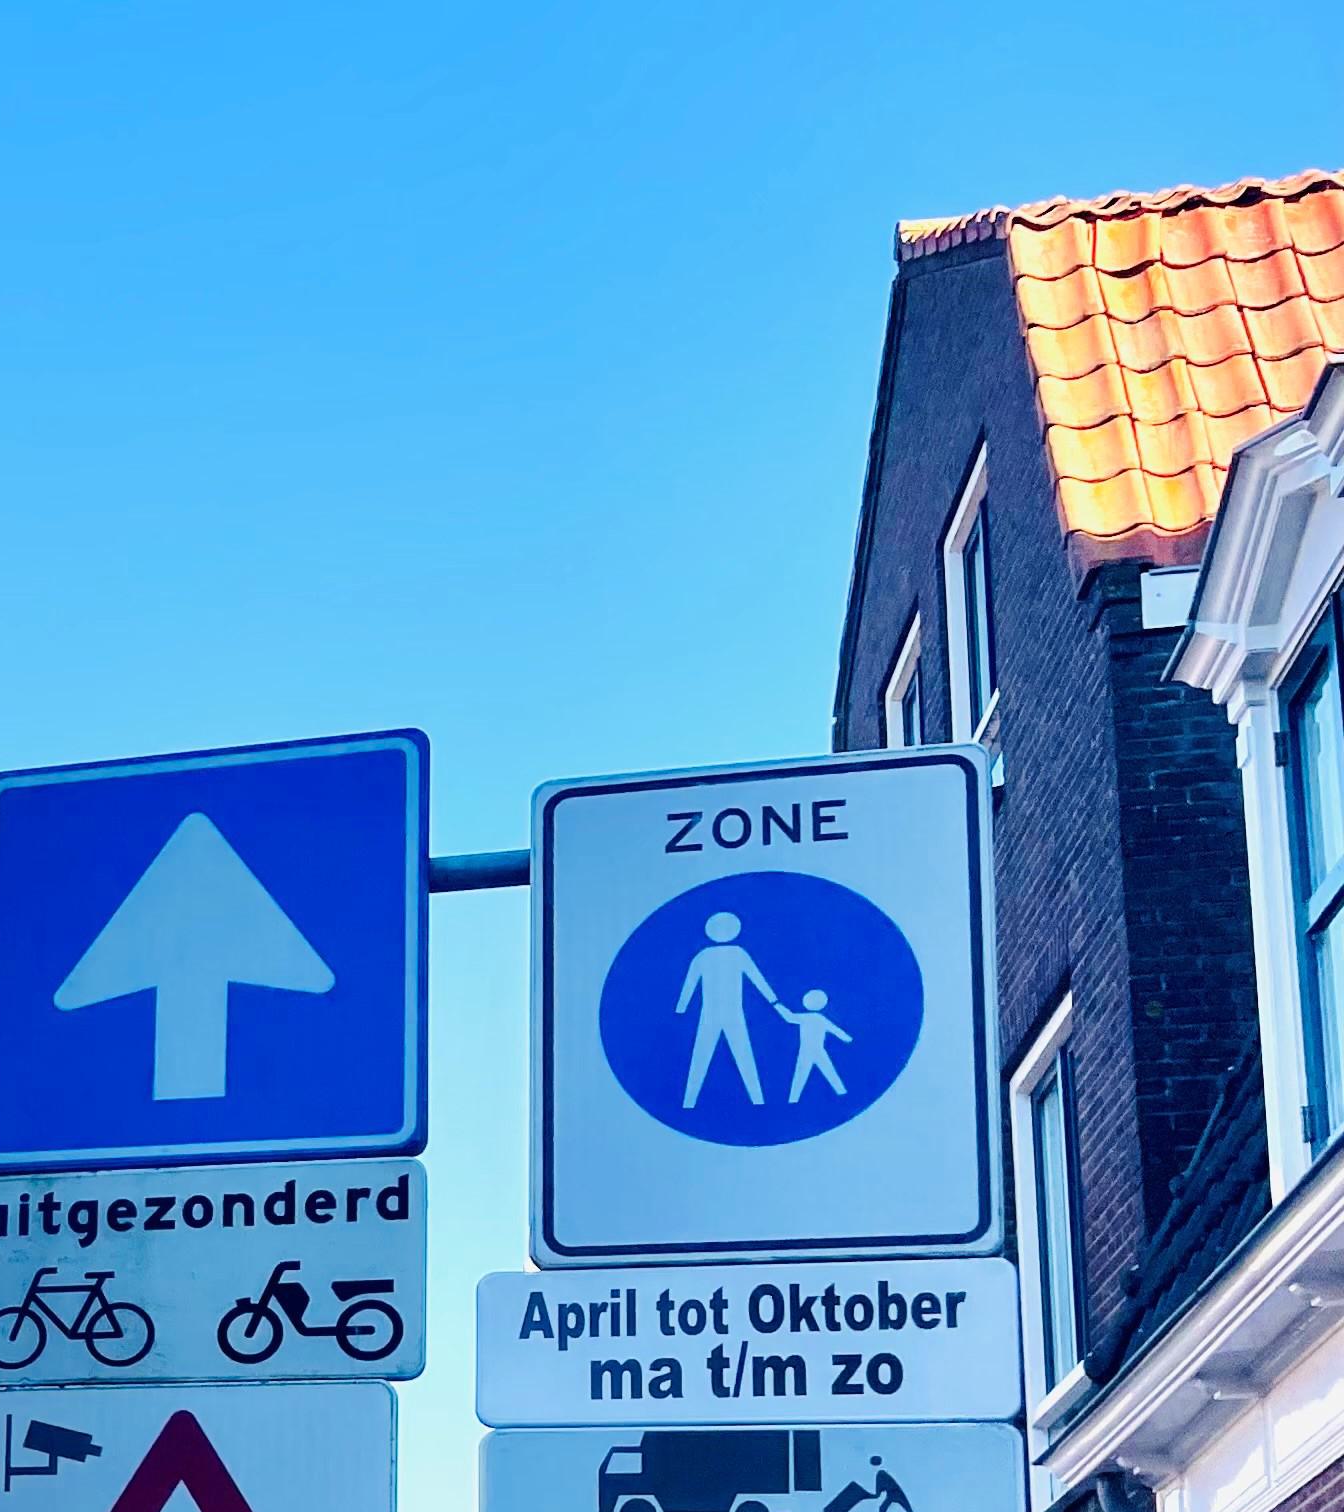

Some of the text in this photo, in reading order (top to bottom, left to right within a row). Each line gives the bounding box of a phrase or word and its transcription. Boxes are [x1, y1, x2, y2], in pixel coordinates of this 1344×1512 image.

[665, 799, 849, 854] ZONE
[518, 1280, 968, 1352] April tot Oktober
[589, 1340, 904, 1401] ma t/m zo
